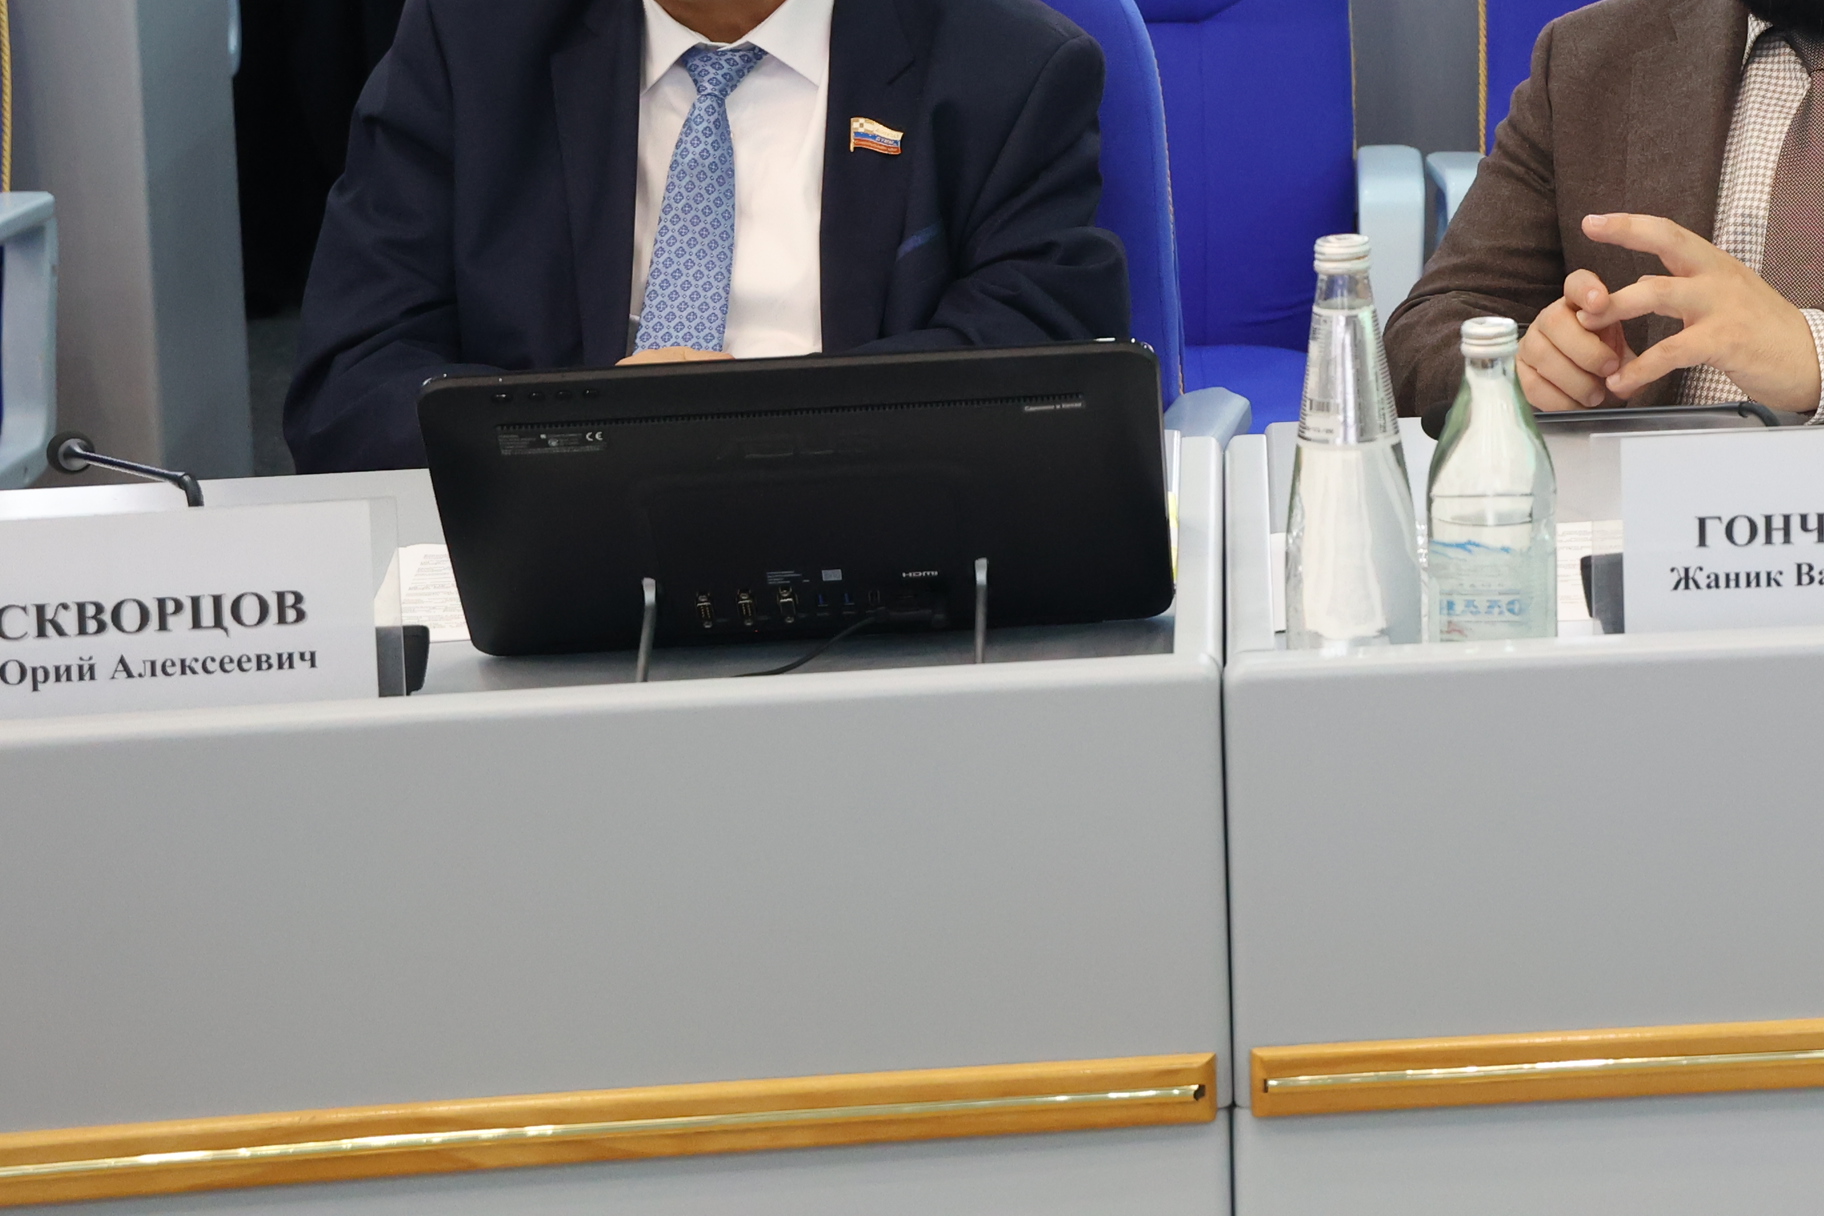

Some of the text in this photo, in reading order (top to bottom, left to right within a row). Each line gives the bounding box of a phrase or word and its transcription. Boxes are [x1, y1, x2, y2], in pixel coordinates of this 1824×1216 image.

[1669, 565, 1784, 591] Жаник
[0, 590, 307, 642] СКВОРЦОВ
[109, 650, 317, 680] Алексеевич
